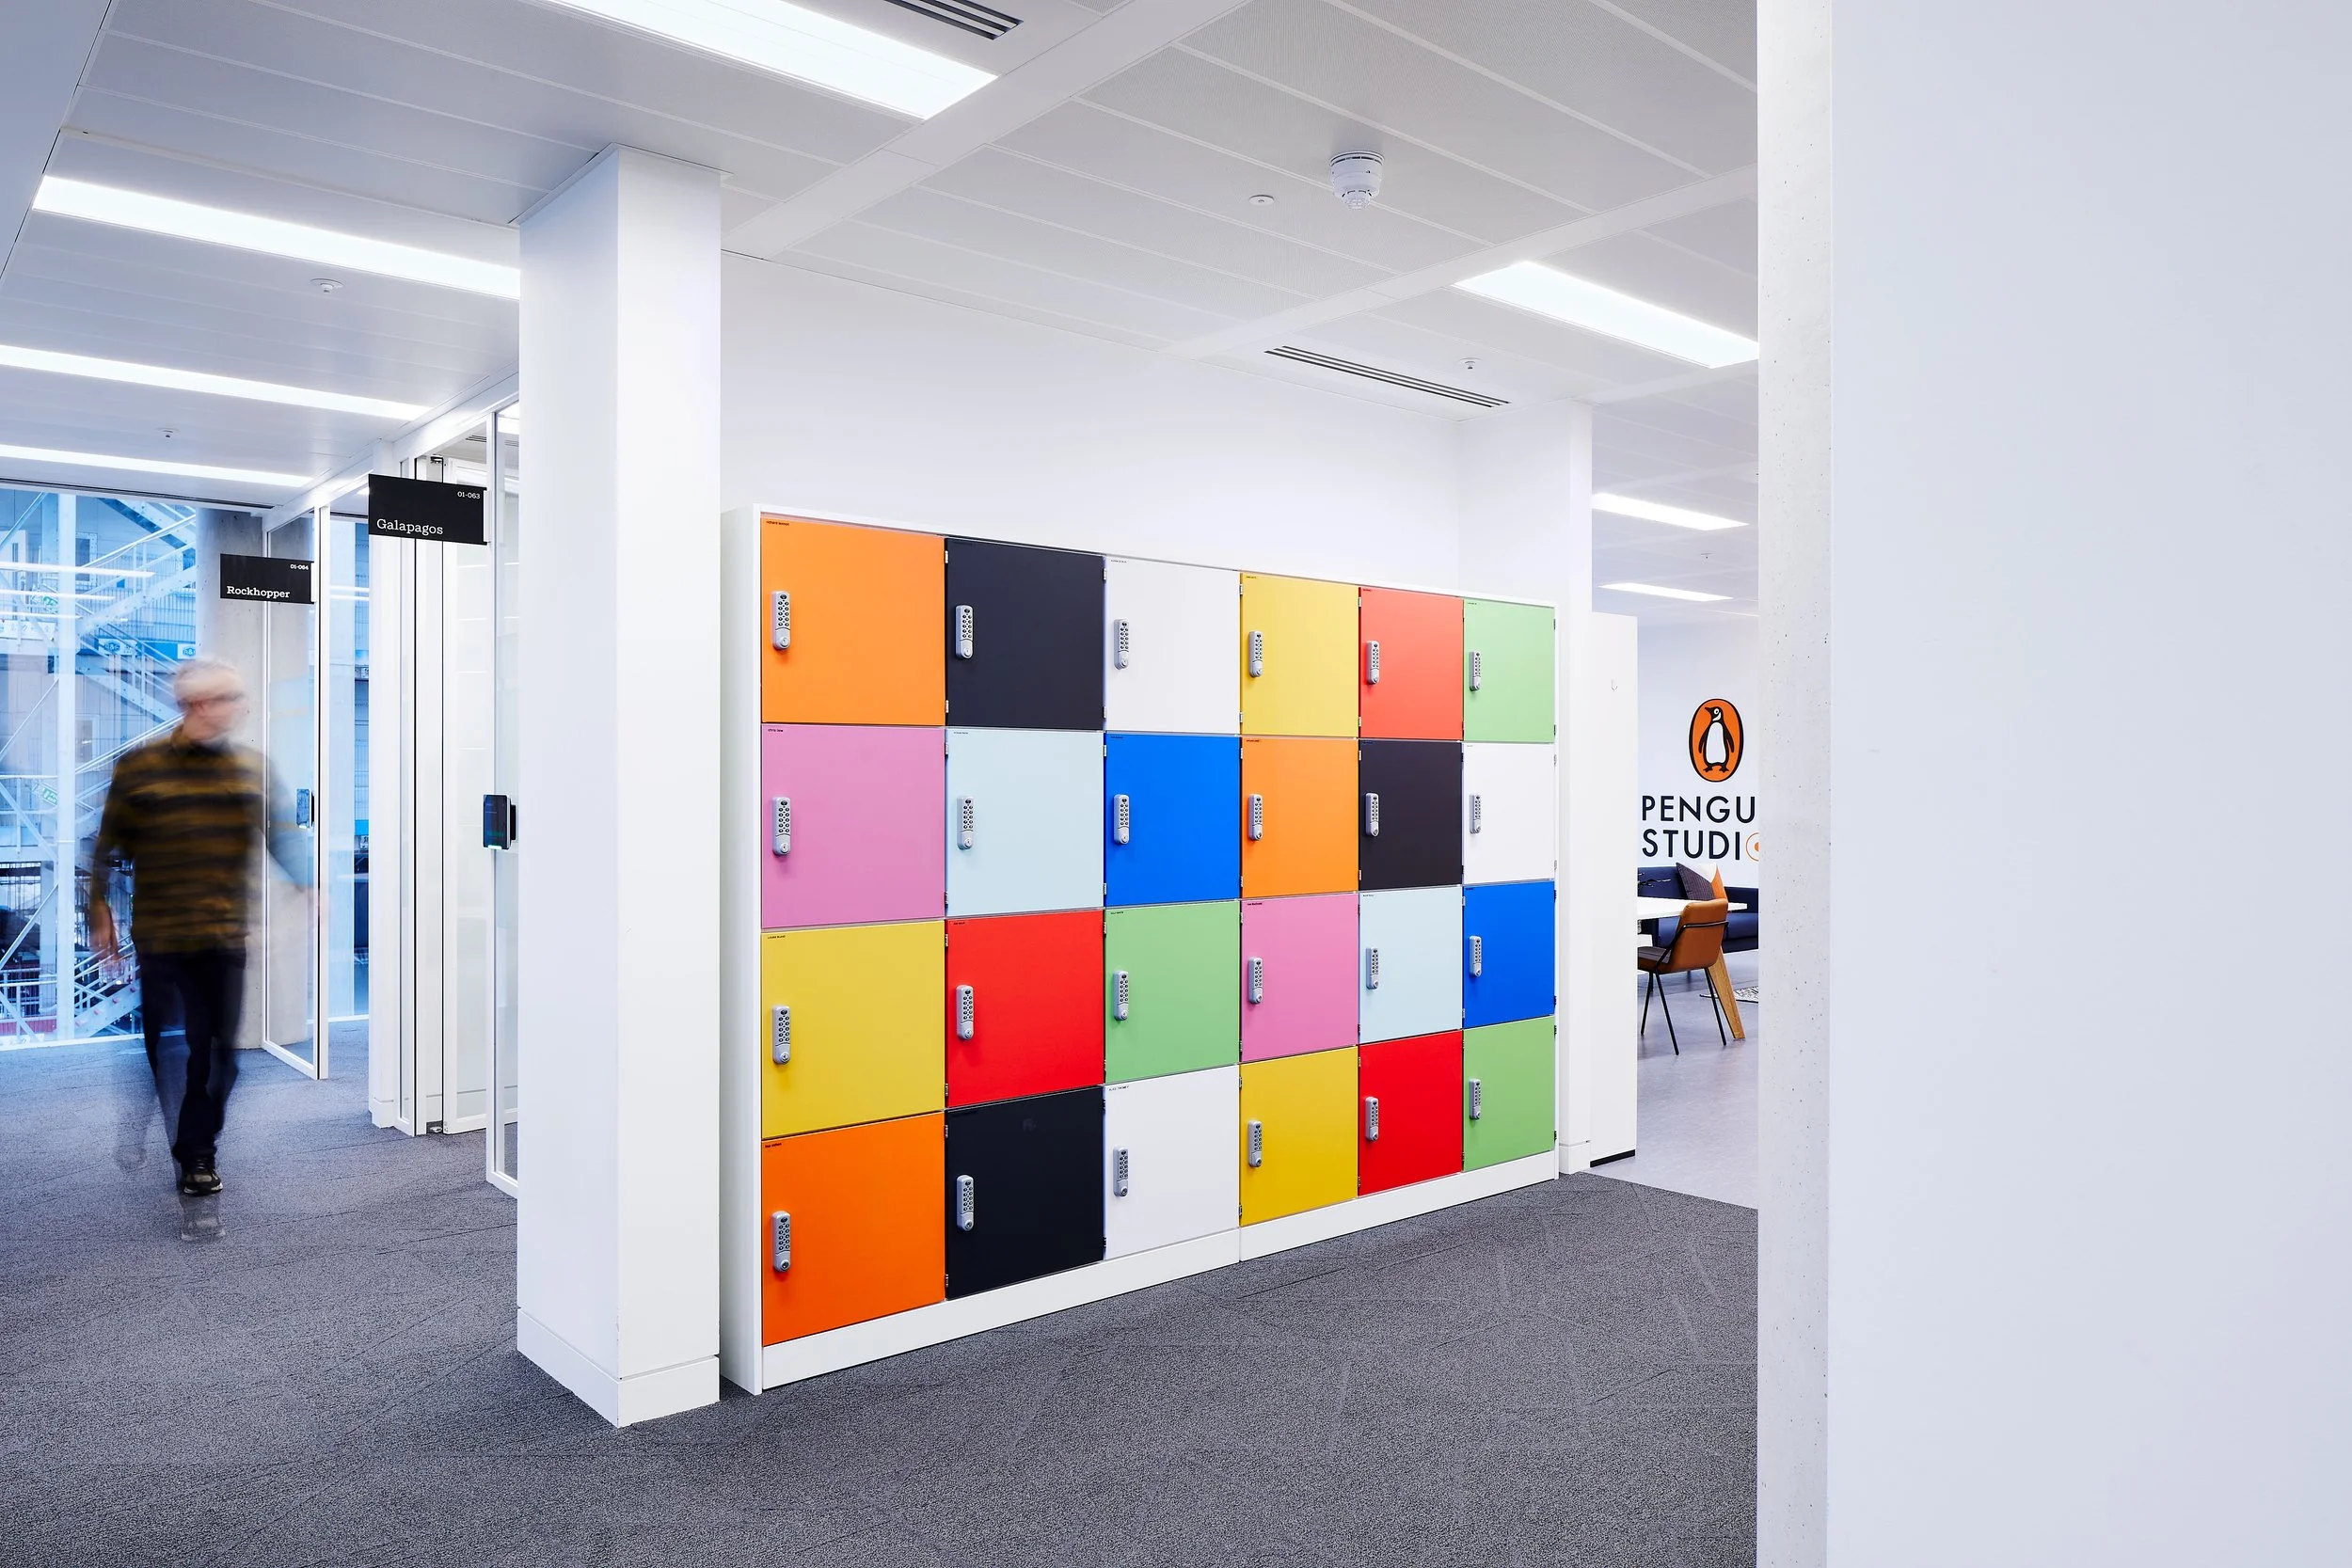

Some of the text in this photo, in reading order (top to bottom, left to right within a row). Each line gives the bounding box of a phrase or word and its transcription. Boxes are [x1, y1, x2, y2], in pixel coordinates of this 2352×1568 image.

[376, 519, 443, 535] Galapagos
[227, 586, 290, 599] Rockhopper
[1642, 795, 1756, 823] PENGU
